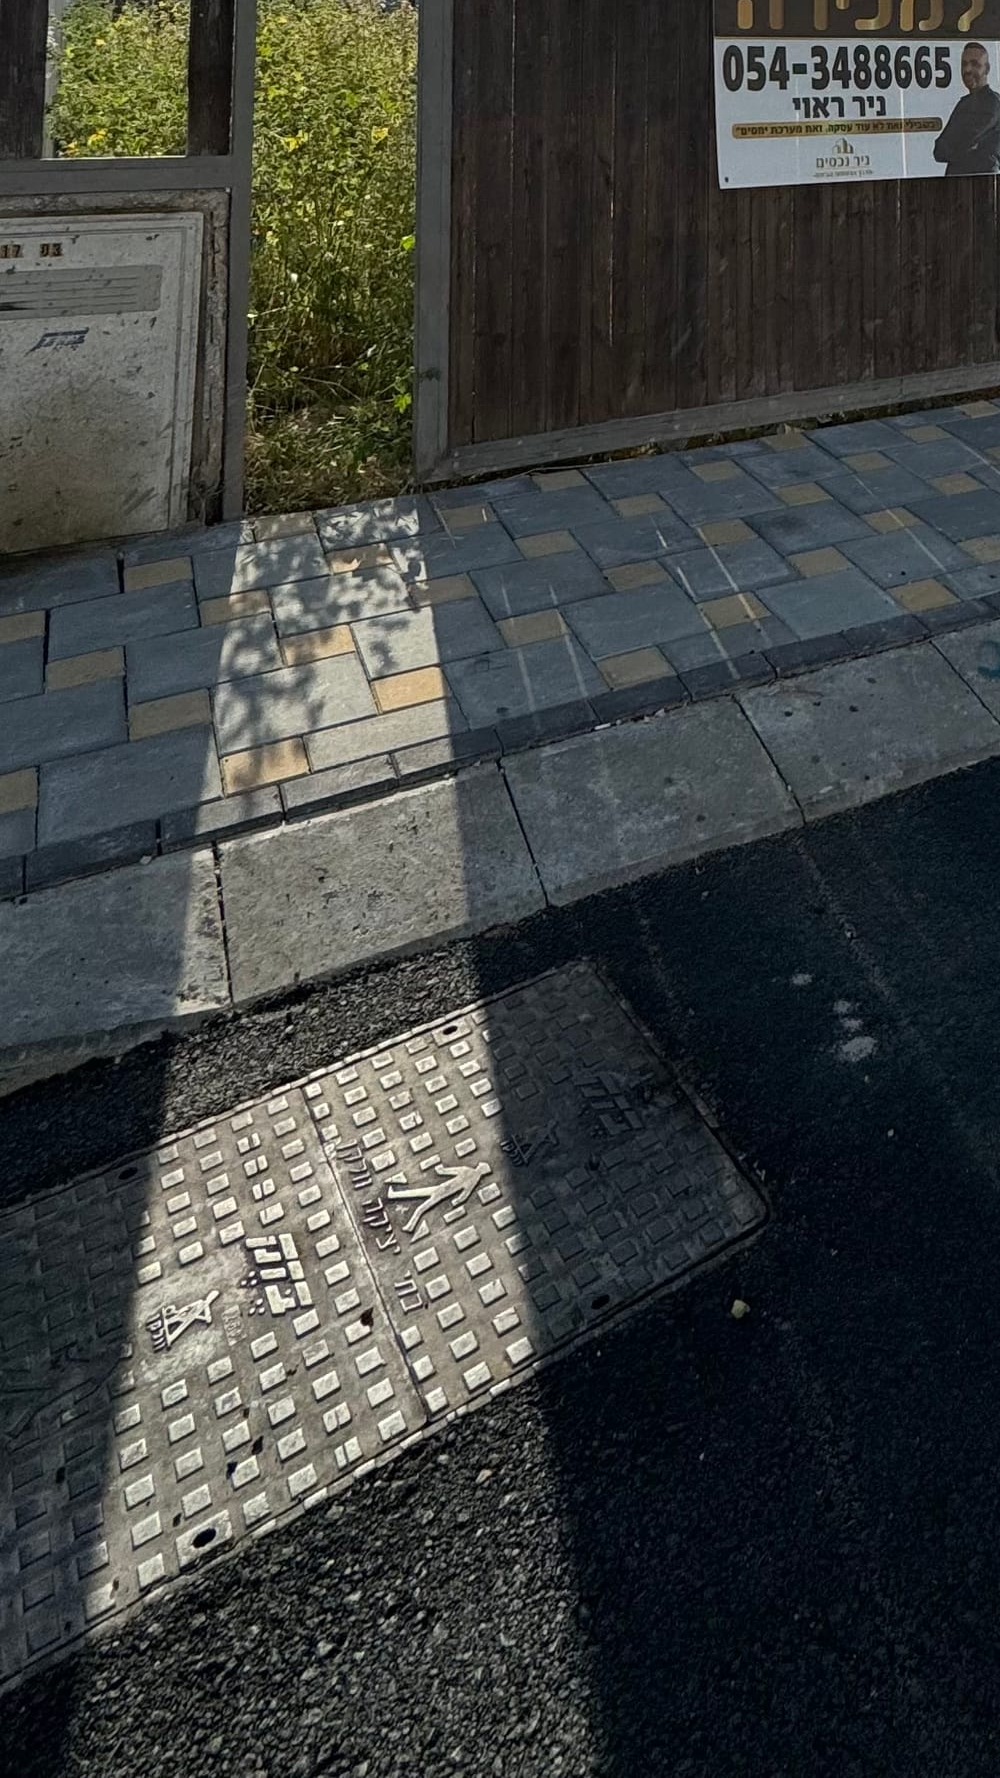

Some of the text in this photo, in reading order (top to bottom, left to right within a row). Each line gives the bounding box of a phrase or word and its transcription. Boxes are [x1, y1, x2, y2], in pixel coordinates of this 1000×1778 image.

[722, 44, 952, 92] 054-3488665
[792, 95, 887, 118] ניר ראוי
[771, 125, 803, 136] מערכת
[805, 125, 823, 133] זאת
[816, 155, 870, 168] ניר נכסים
[335, 1138, 373, 1191] וולקן
[361, 1197, 401, 1256] יציקה
